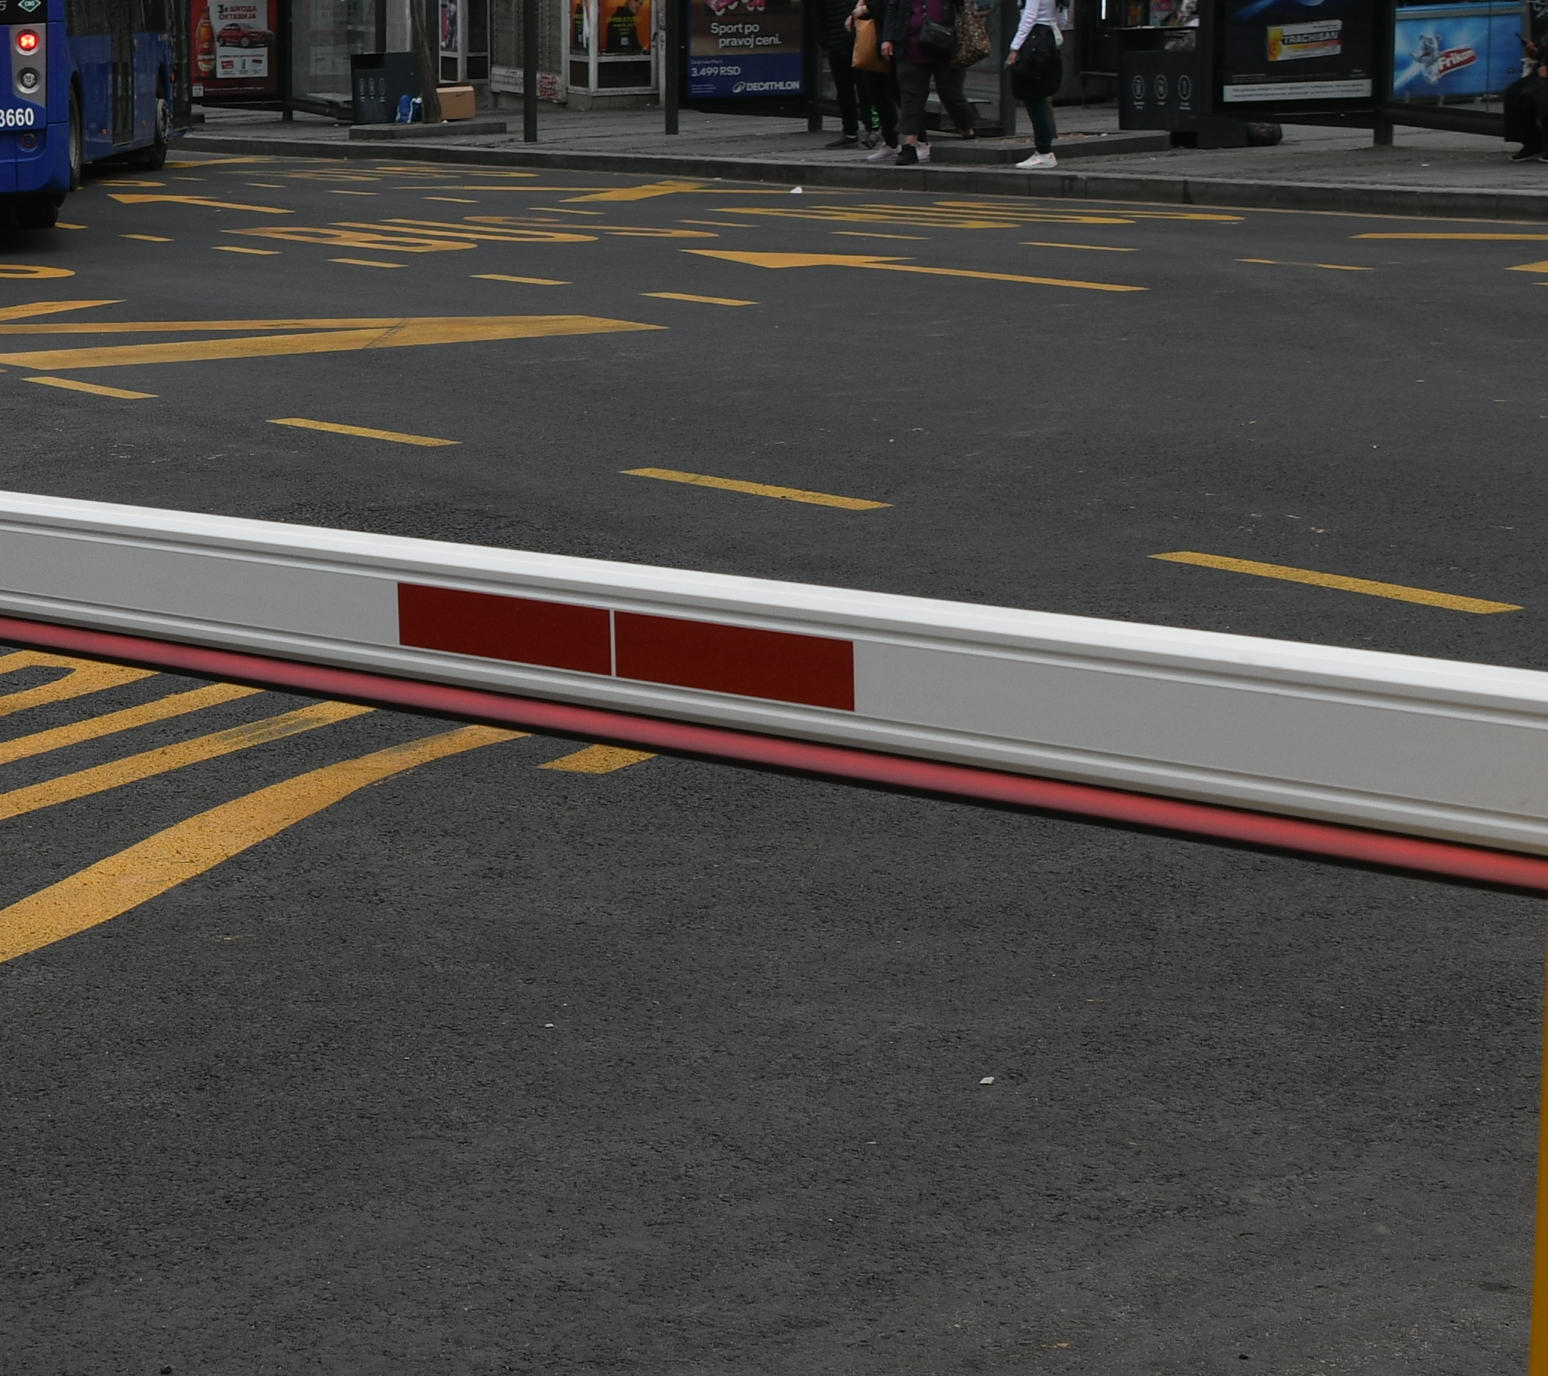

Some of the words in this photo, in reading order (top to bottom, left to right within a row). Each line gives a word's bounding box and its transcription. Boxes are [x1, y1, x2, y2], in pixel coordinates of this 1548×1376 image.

[710, 22, 743, 35] Sport
[744, 23, 760, 35] po
[718, 35, 755, 49] pravoj
[756, 34, 783, 45] ceni.
[220, 217, 720, 253] BUS
